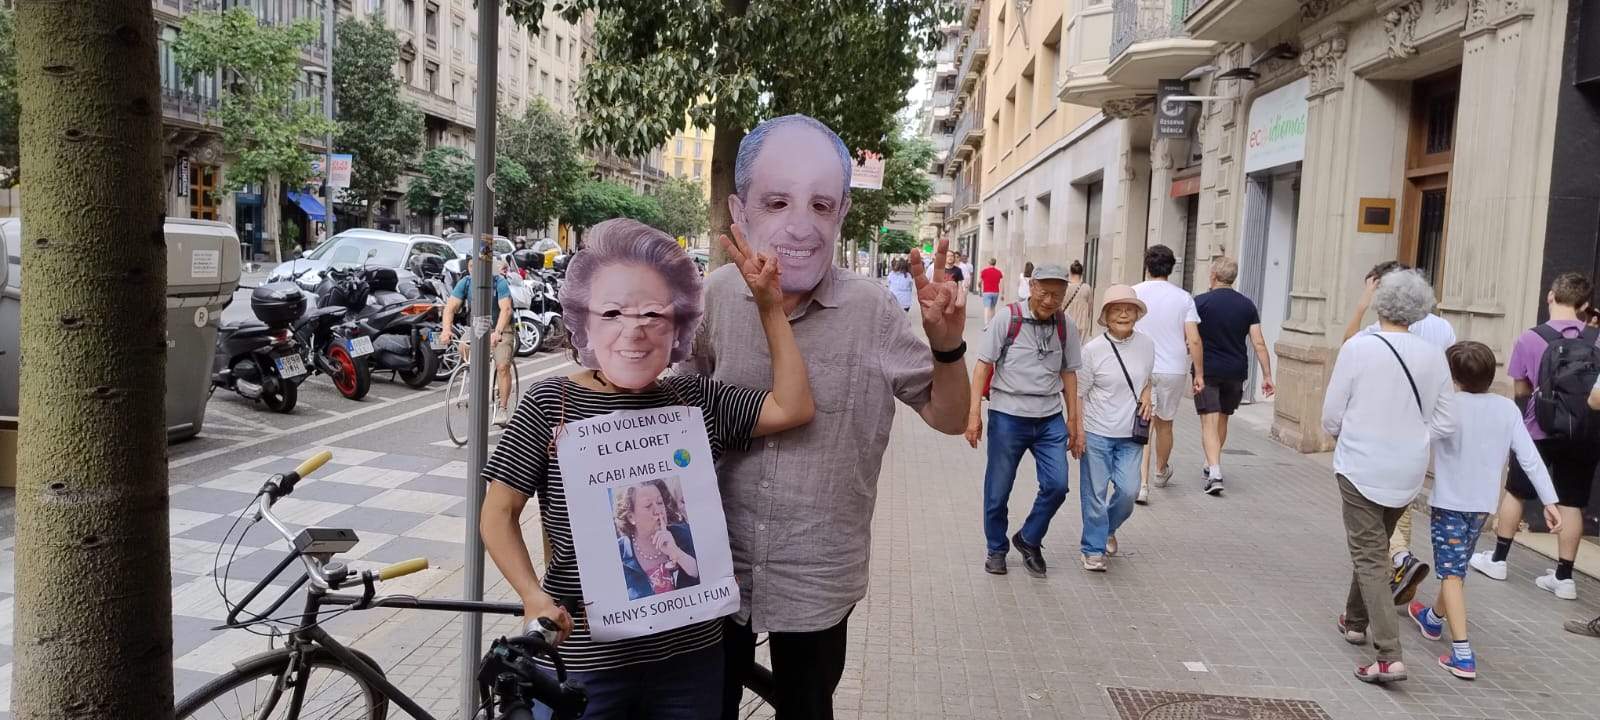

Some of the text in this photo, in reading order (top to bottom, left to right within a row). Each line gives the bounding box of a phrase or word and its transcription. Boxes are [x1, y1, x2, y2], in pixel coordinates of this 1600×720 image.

[578, 411, 682, 438] SI NO VOLEM QUE
[597, 444, 612, 456] EL
[615, 433, 671, 453] CALORET
[588, 460, 673, 486] ACABI AMB EL
[602, 586, 731, 626] MENYS SOROLL I FUM
